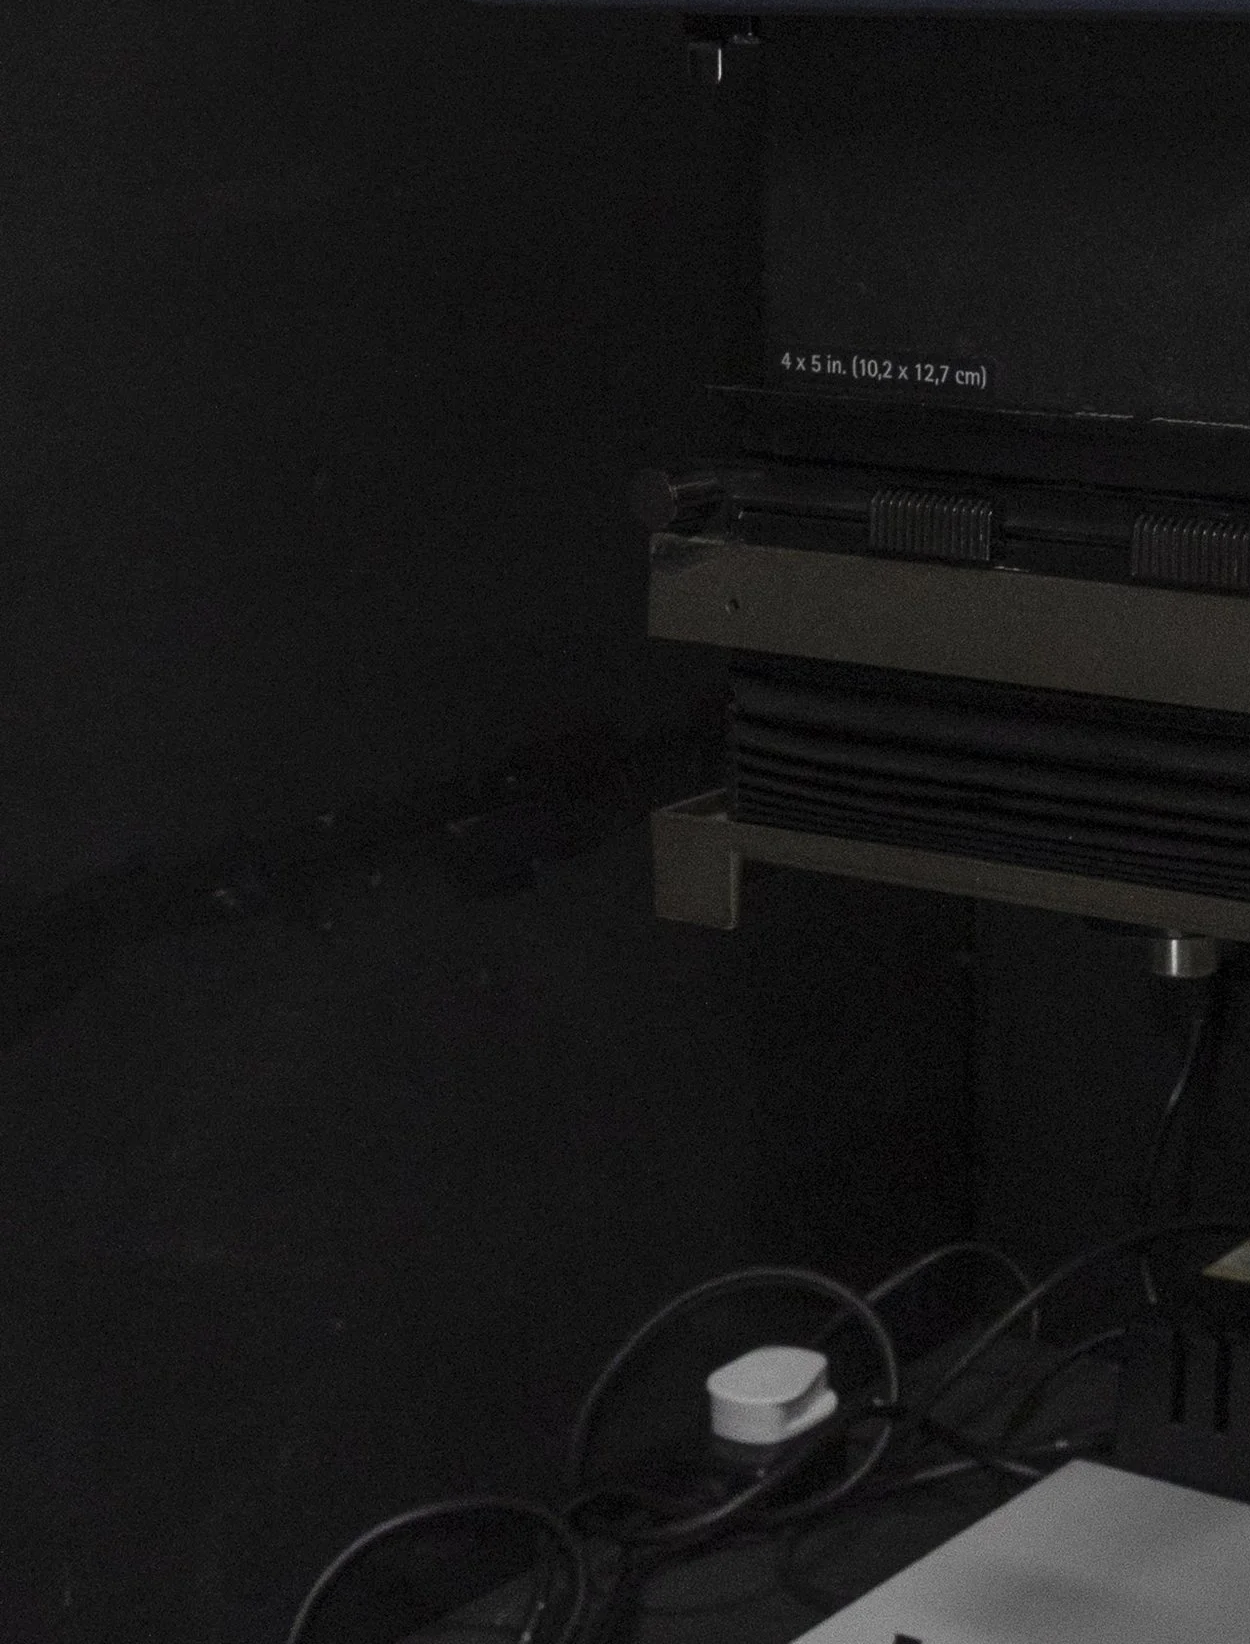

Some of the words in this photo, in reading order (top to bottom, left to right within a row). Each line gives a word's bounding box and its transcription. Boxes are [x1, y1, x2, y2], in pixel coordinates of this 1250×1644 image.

[781, 352, 792, 370] 4
[796, 357, 806, 371] x
[811, 355, 822, 373] 5
[827, 354, 847, 376] in.
[852, 355, 892, 381] (10,2
[898, 365, 909, 381] x
[914, 363, 950, 386] 12,7
[955, 365, 987, 390] cm)
